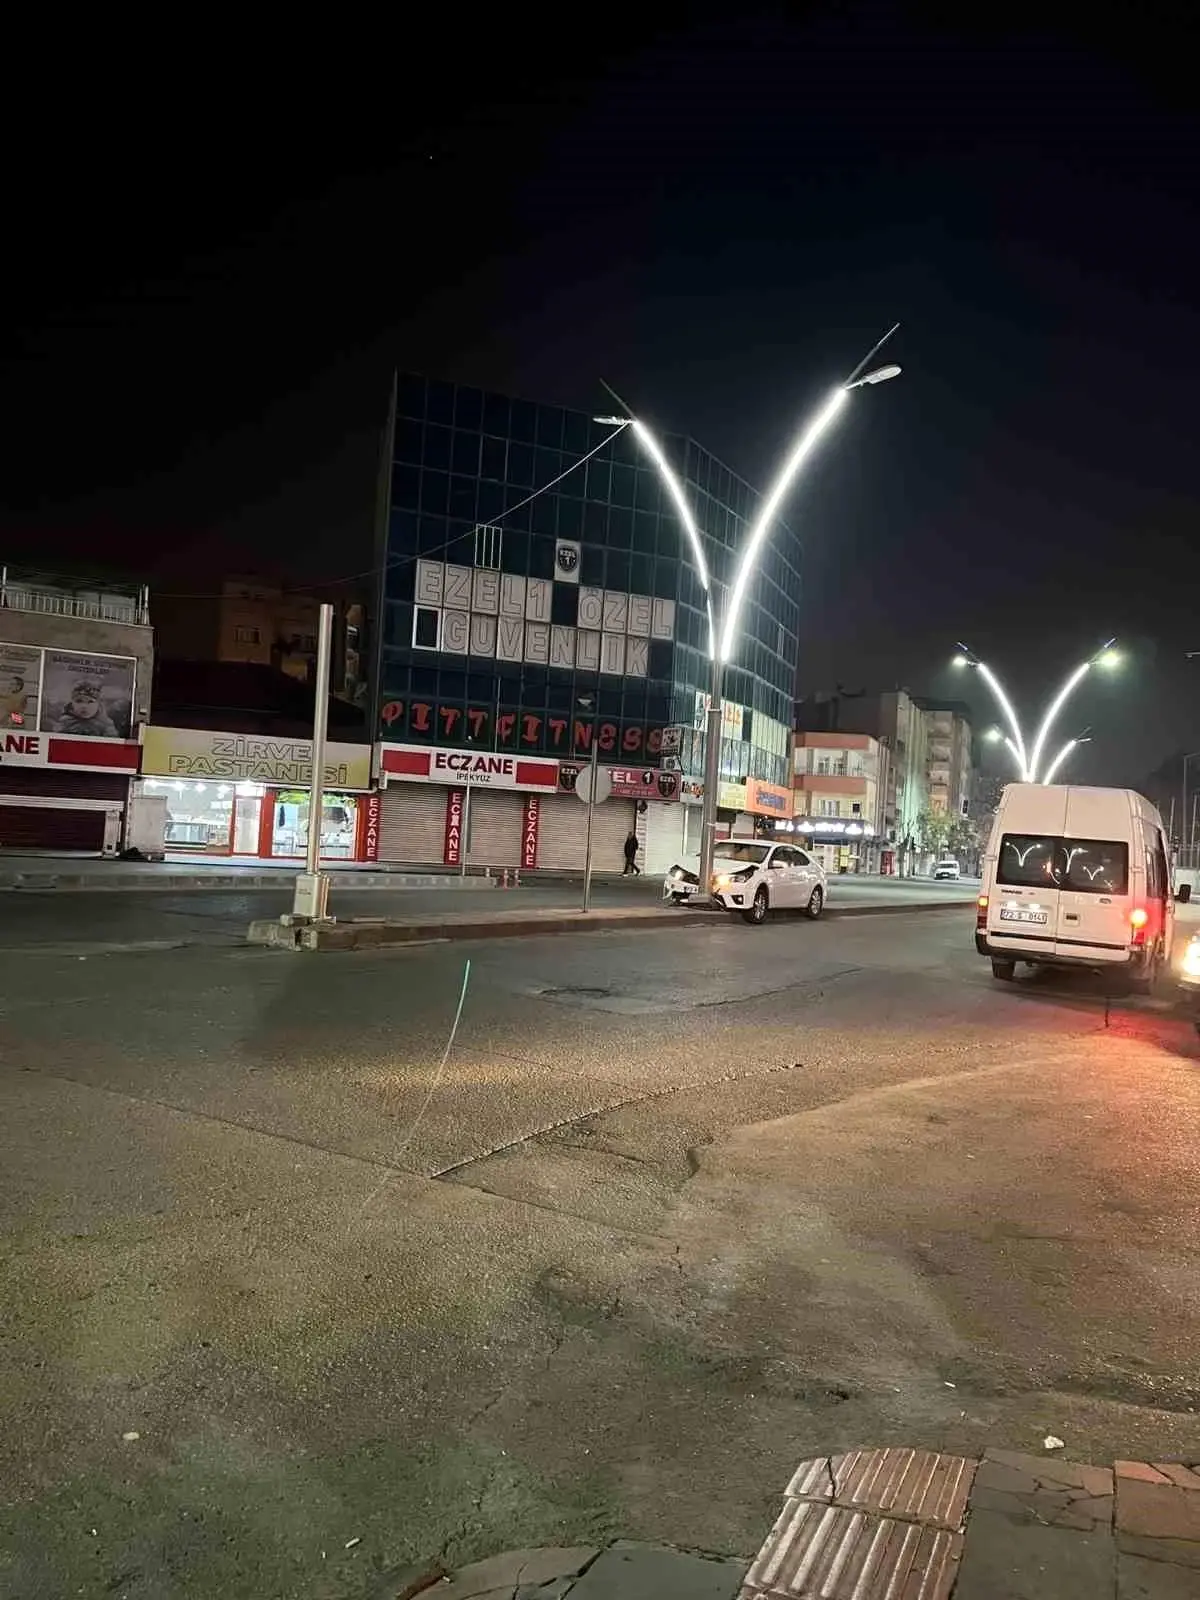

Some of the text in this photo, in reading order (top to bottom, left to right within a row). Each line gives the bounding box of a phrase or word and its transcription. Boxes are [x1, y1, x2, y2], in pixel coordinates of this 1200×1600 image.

[211, 736, 313, 762] ZİRVE
[435, 752, 513, 776] ECZANE
[168, 754, 348, 786] PASTANESİ
[367, 798, 379, 857] ECZANE
[526, 799, 538, 865] ECZANE
